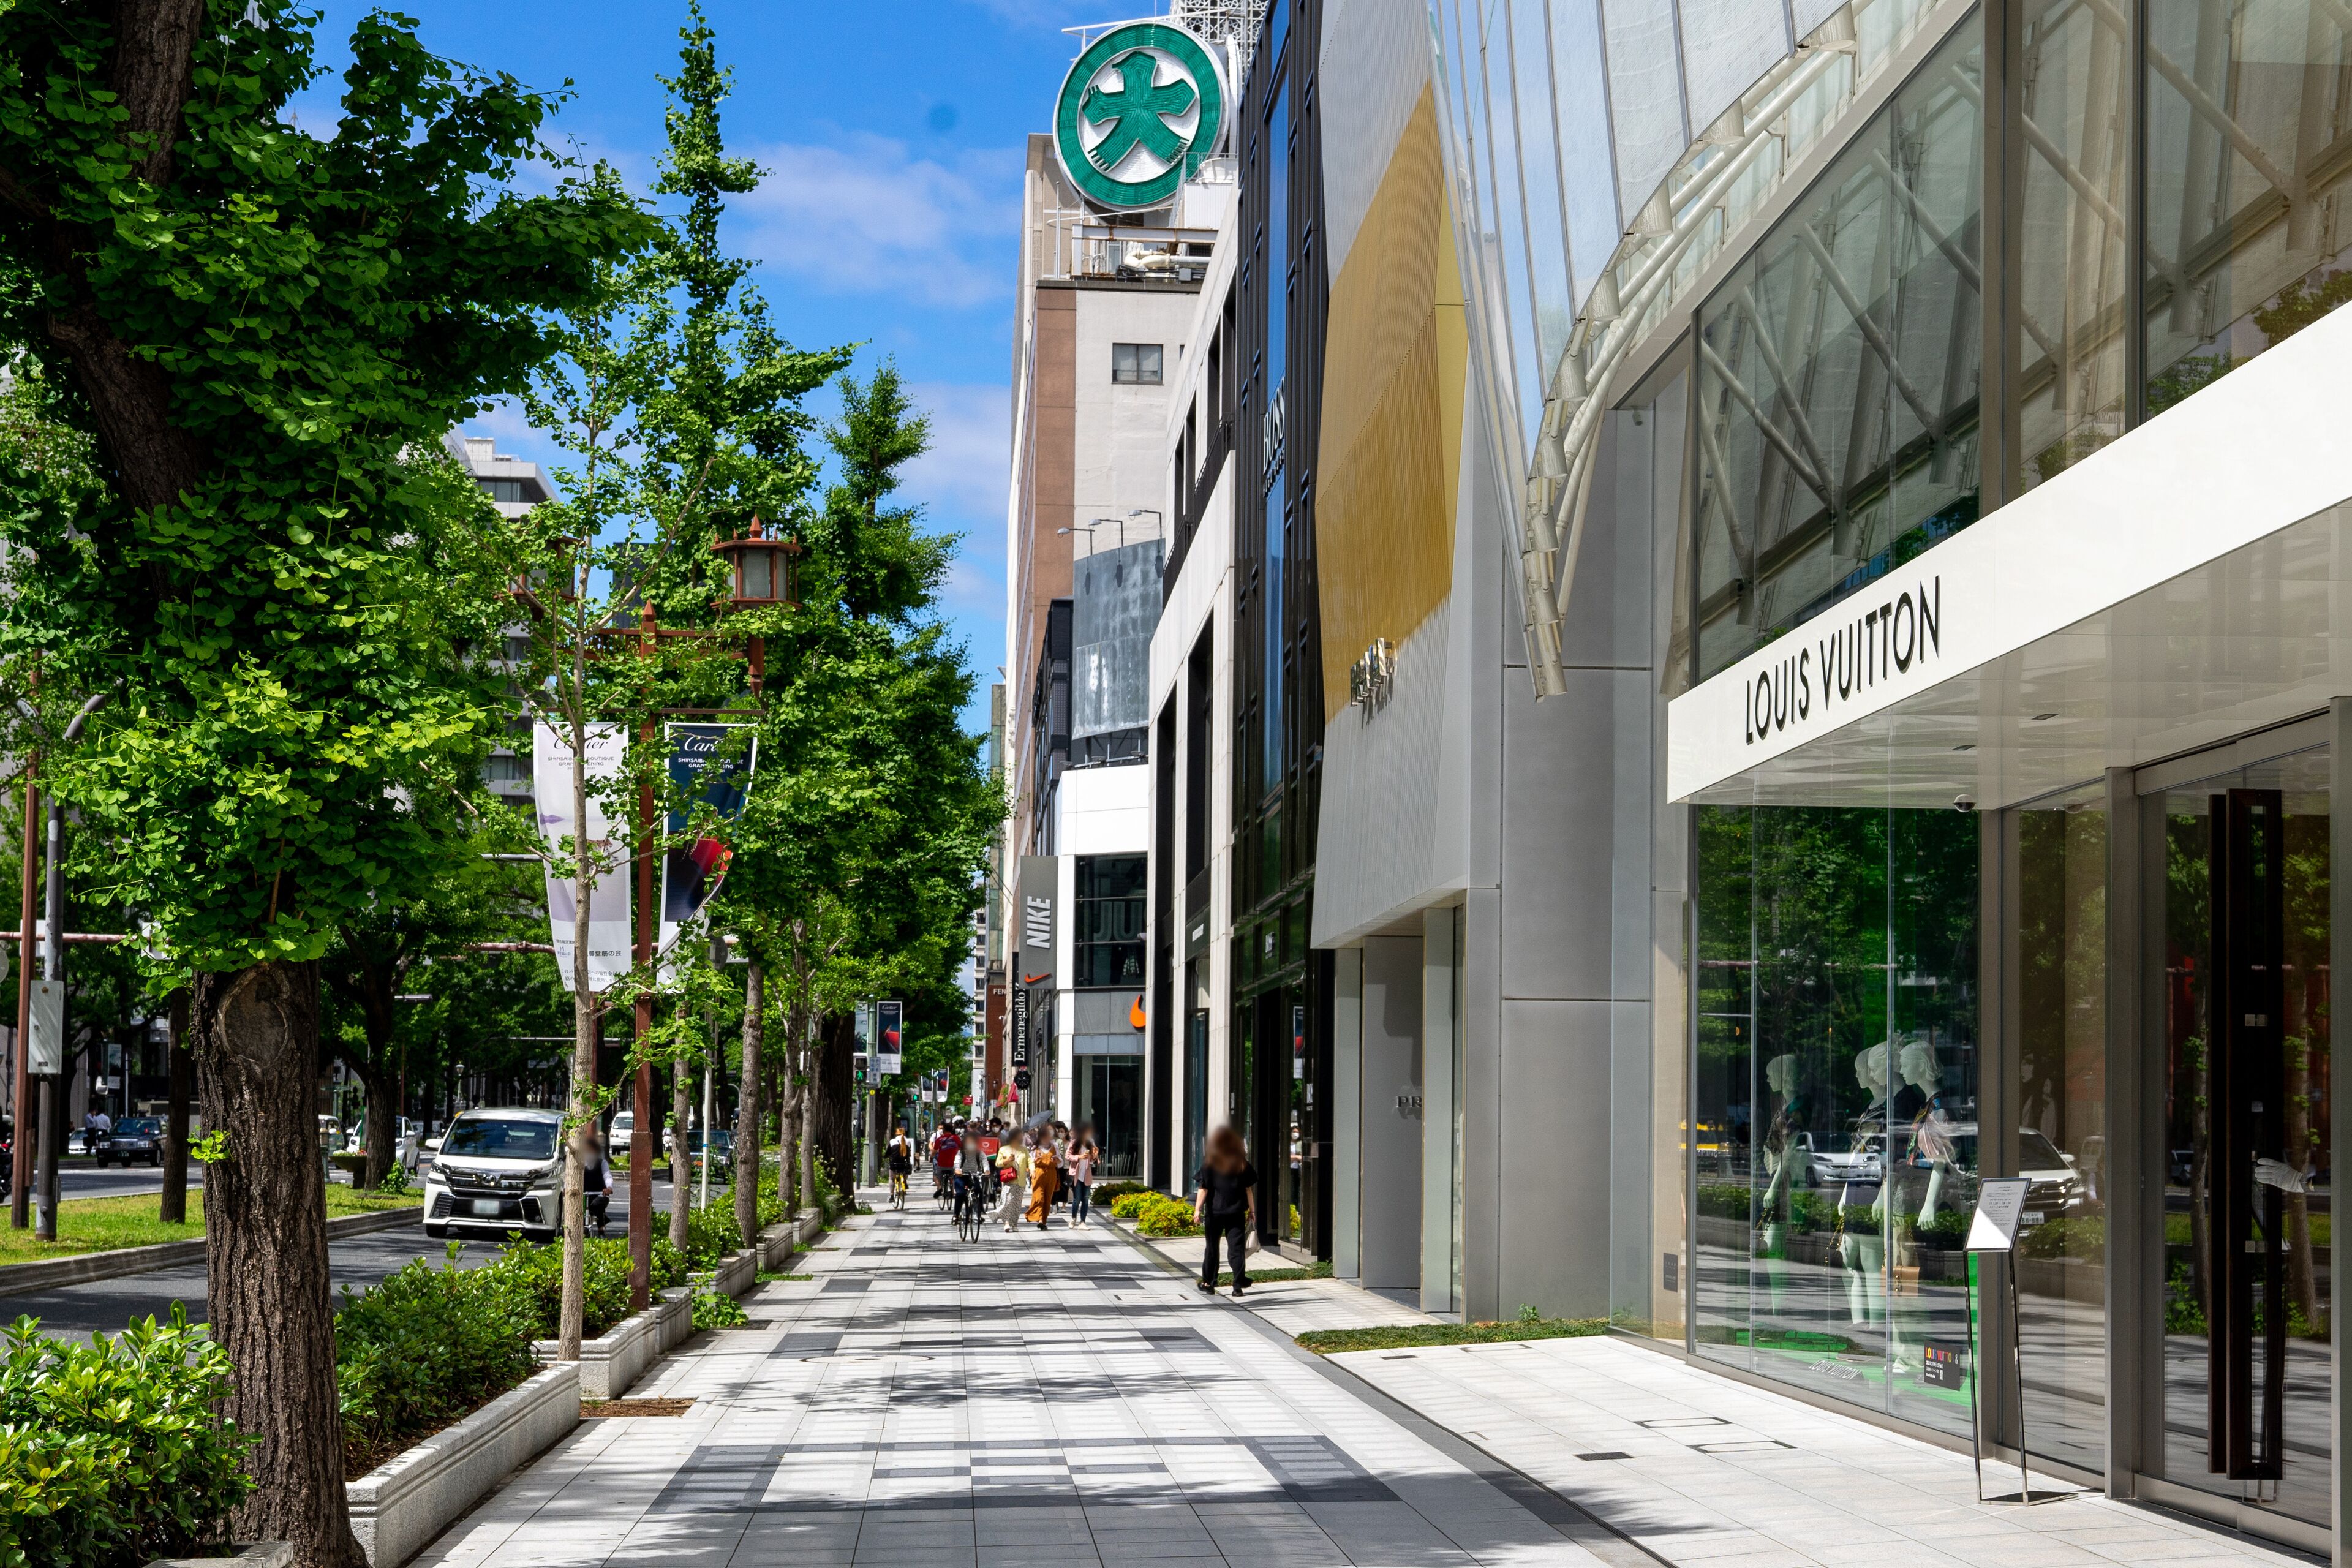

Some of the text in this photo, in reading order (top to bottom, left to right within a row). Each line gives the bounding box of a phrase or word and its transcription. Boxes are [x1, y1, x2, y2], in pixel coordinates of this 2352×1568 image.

[1264, 376, 1285, 475] BOSS
[1746, 575, 1940, 745] LOUIS VUITTON
[554, 737, 608, 750] Cier
[684, 736, 724, 752] Cart
[1027, 895, 1051, 949] NIKE
[1014, 992, 1028, 1062] Ermenegildo
[1809, 1359, 1863, 1380] LOUIS VUITTON
[1925, 1347, 1937, 1360] LOUIS
